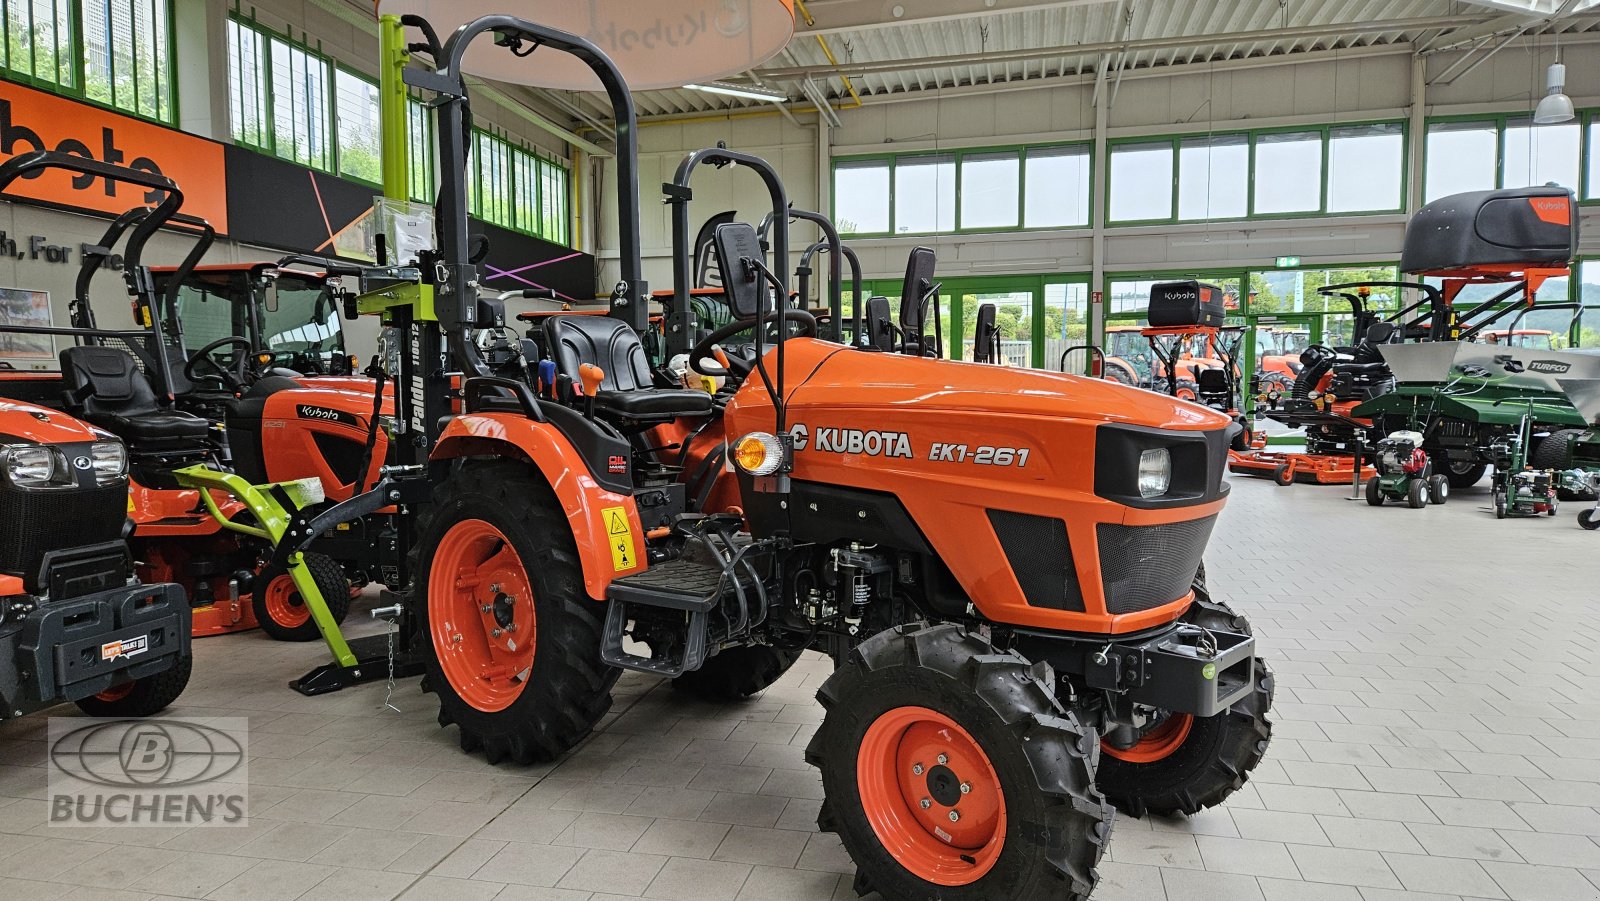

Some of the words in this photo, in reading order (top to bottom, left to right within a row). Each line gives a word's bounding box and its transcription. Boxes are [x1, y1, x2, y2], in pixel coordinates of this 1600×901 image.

[1537, 201, 1566, 210] Kubota
[31, 234, 72, 264] For
[1164, 291, 1195, 299] Kubota
[411, 323, 420, 366] 1100-12
[1531, 362, 1567, 372] TURFCO
[411, 376, 425, 433] Paldu
[302, 405, 339, 420] Kubota
[815, 427, 913, 459] KUBOTA
[928, 442, 1030, 467] EK1-261
[609, 455, 626, 465] OIL
